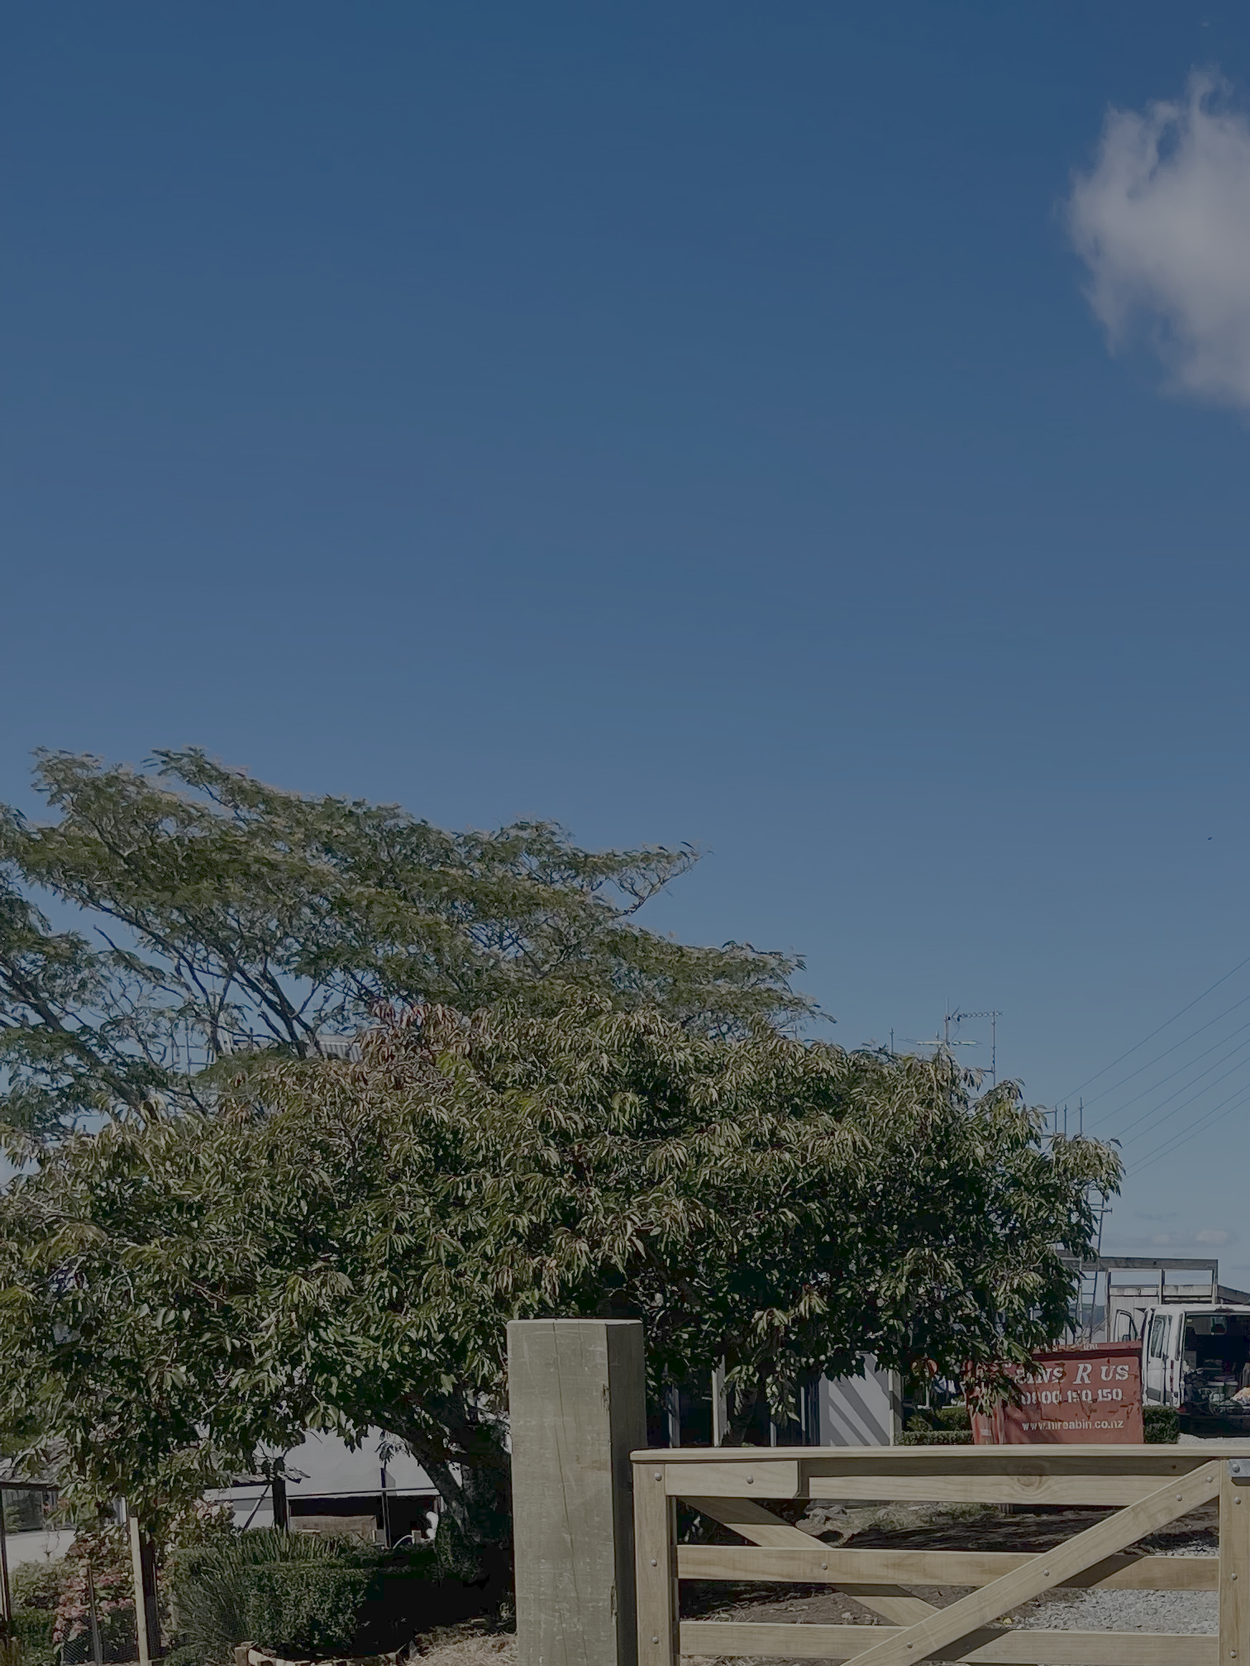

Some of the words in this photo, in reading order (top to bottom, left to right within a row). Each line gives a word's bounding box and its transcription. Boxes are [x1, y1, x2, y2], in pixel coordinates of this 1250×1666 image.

[1073, 1363, 1092, 1384] R
[1100, 1365, 1129, 1381] US
[1021, 1390, 1062, 1405] 0800
[1097, 1388, 1123, 1402] 150
